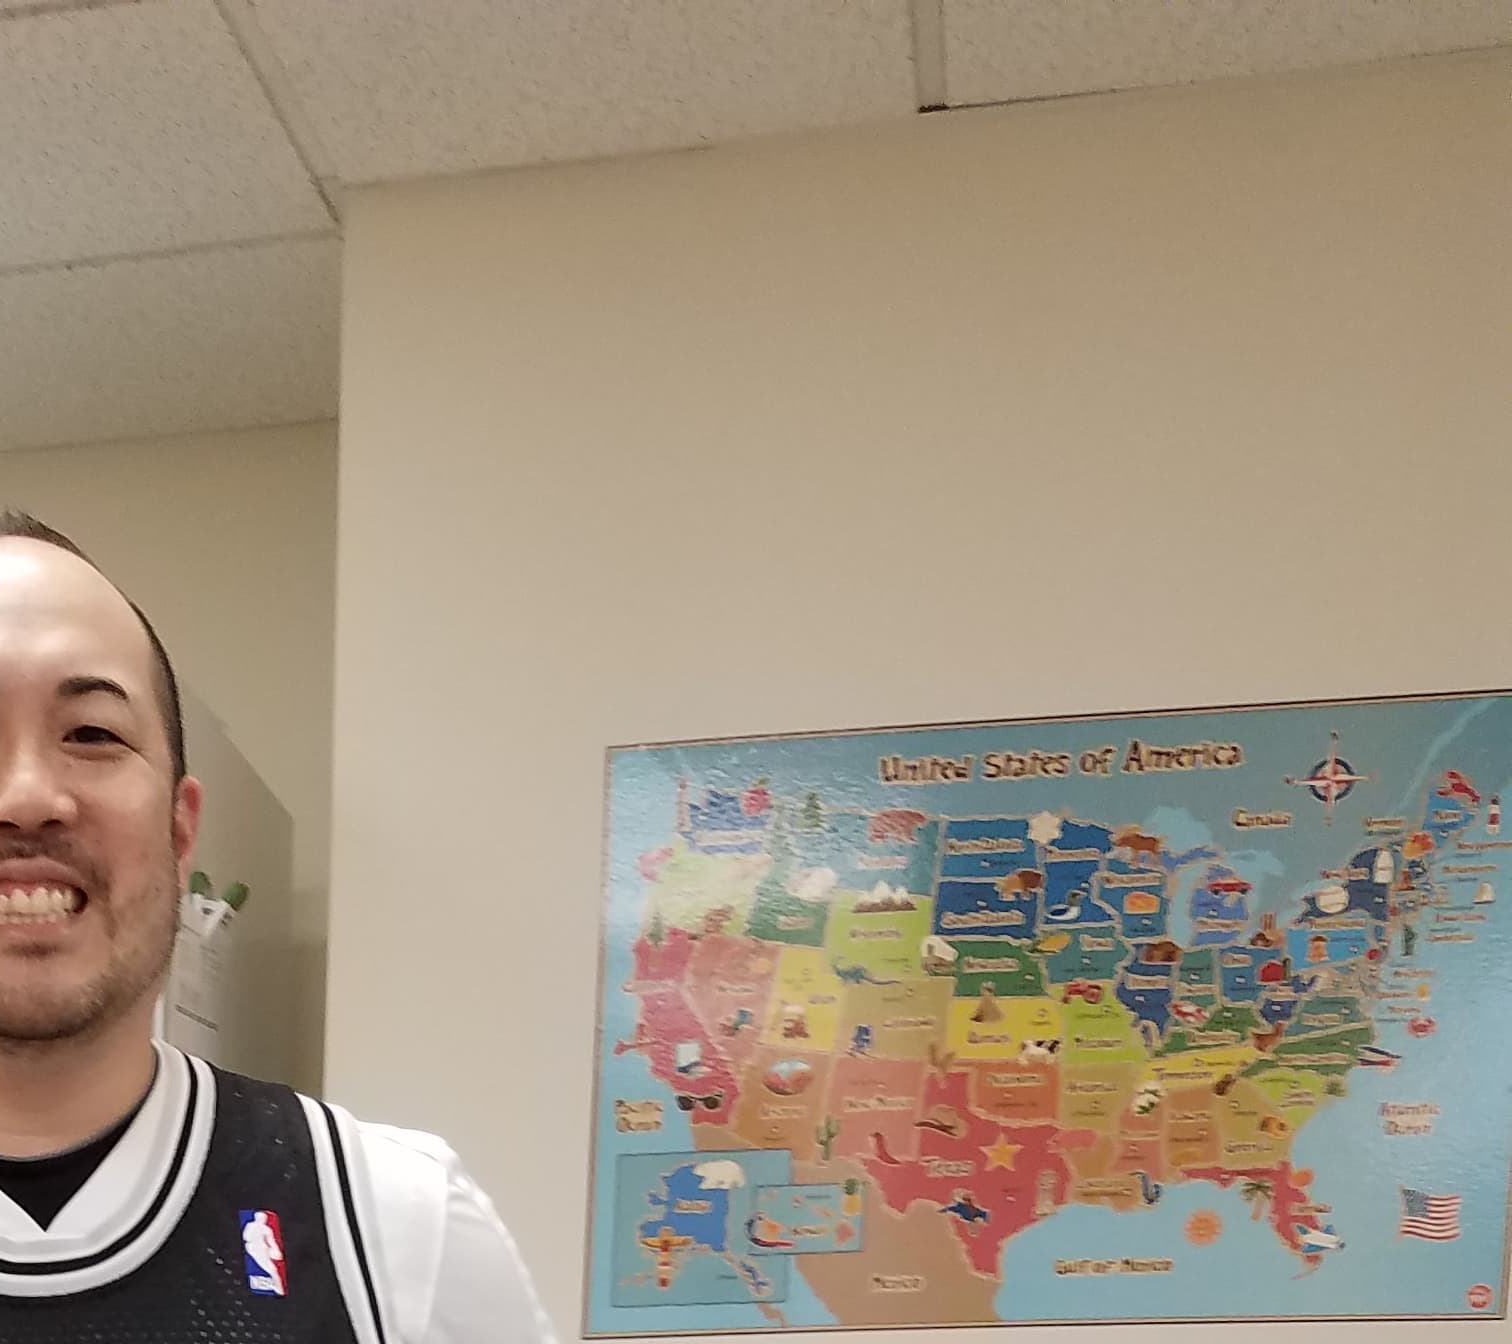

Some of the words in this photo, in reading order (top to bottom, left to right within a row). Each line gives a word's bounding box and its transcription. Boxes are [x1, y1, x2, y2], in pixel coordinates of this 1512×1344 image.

[881, 754, 973, 783] United
[983, 751, 1071, 779] States
[1080, 746, 1116, 775] of
[1121, 739, 1245, 772] America
